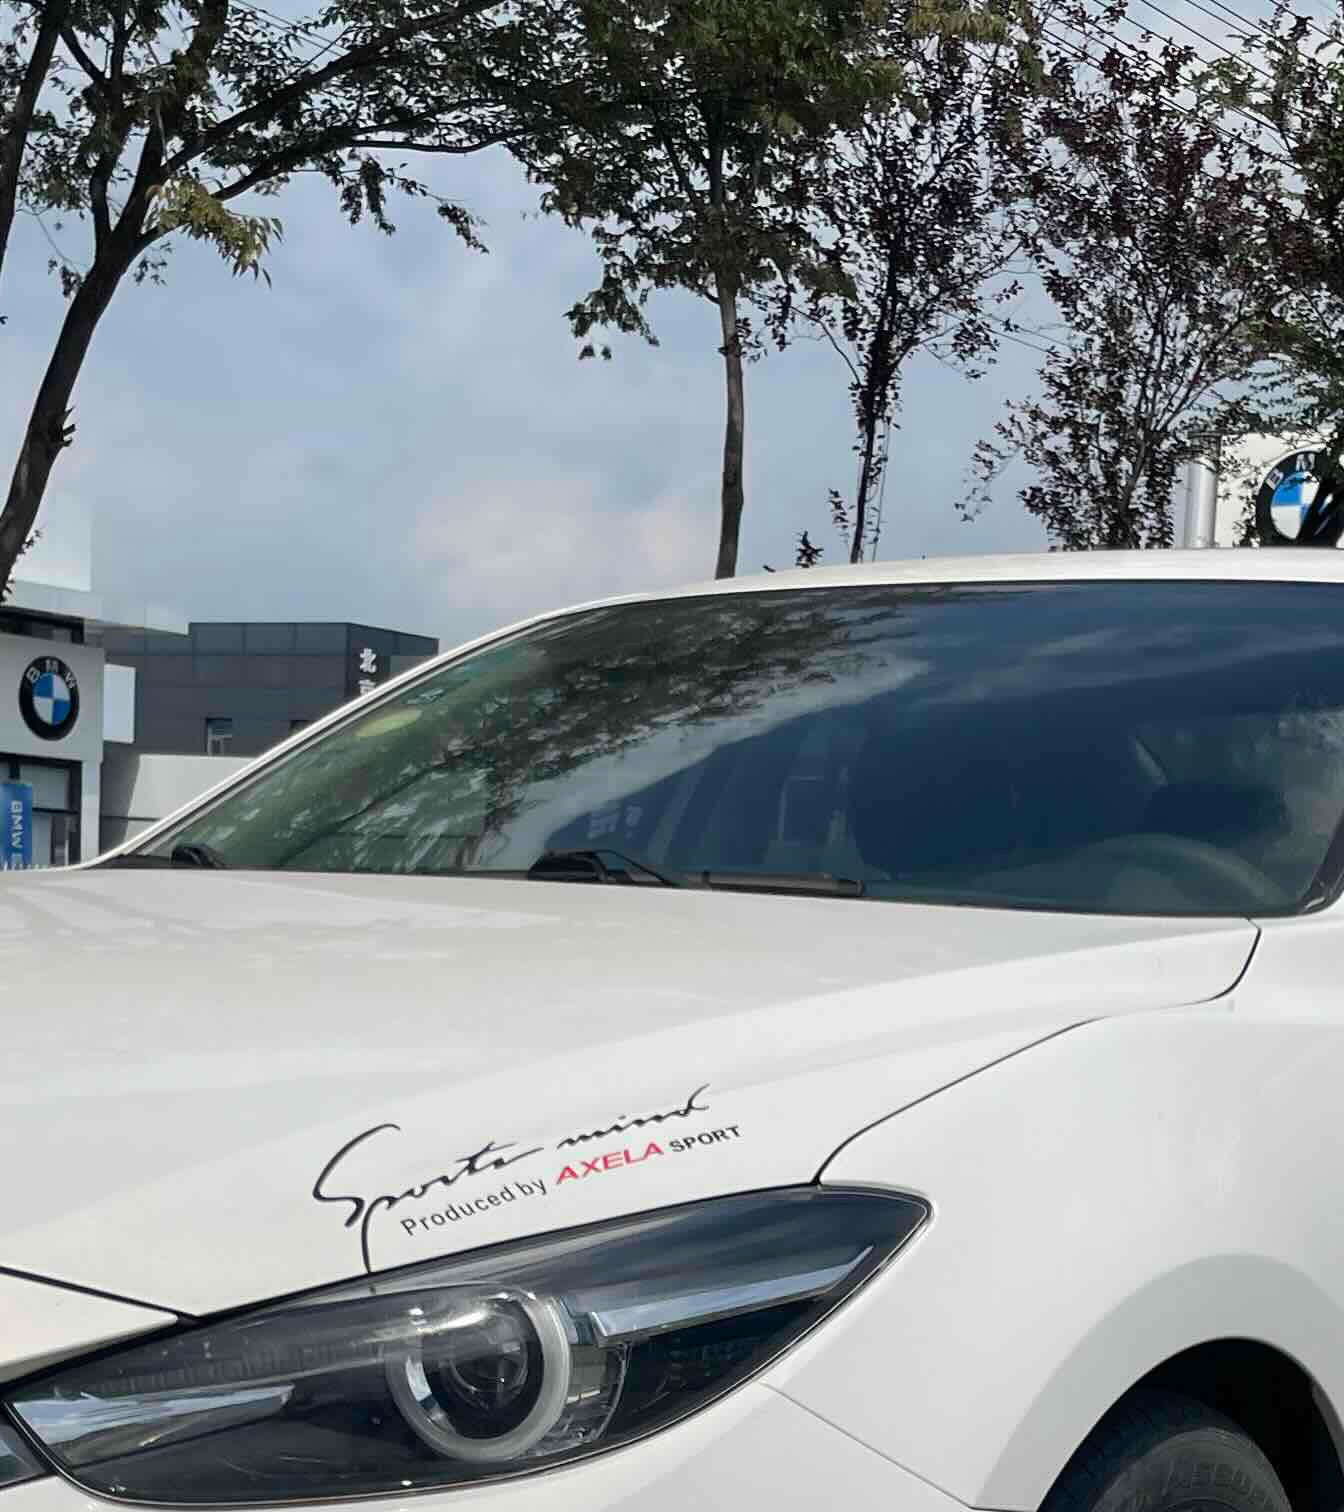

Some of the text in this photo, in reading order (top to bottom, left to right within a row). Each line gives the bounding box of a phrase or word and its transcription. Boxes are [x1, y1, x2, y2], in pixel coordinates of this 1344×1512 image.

[10, 799, 24, 849] BMW
[400, 1125, 743, 1236] Produced by AXELA SPORT
